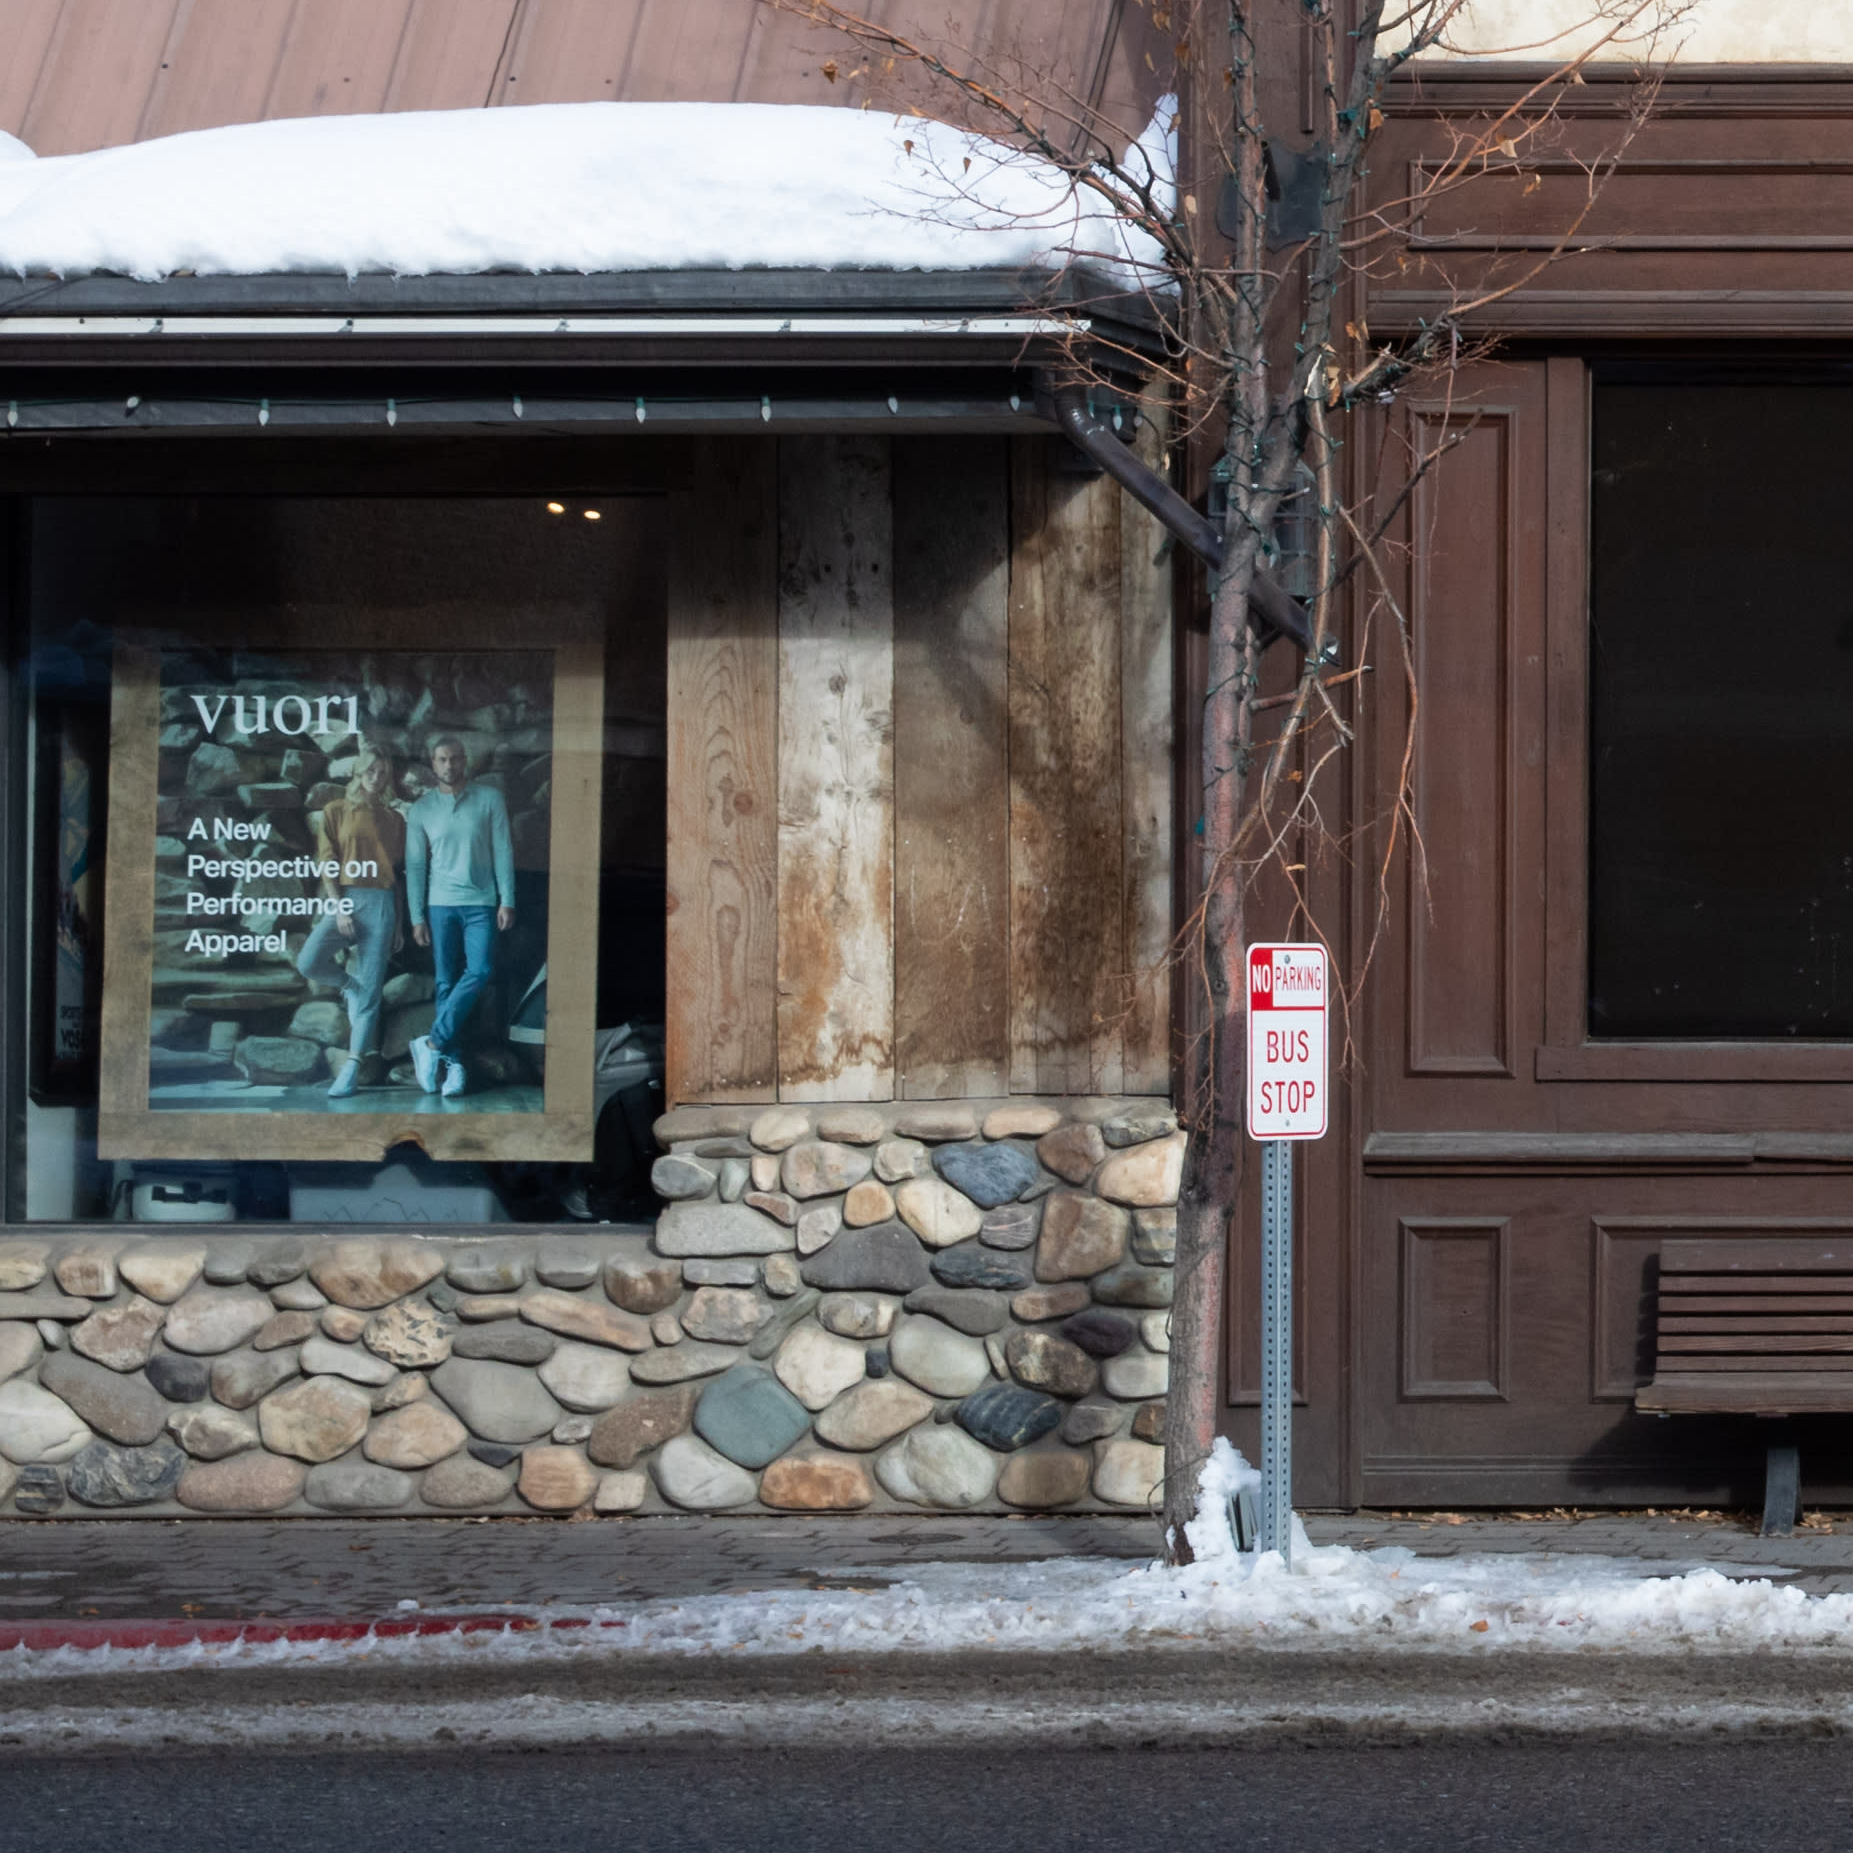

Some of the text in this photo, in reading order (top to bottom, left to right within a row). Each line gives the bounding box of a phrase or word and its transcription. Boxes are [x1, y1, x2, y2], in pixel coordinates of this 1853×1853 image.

[190, 694, 363, 736] vuori
[187, 817, 272, 841] A New
[188, 854, 378, 884] Perspective on
[187, 891, 354, 916] Performance
[185, 930, 287, 958] Apparel
[1252, 964, 1321, 993] NO PARKING
[1266, 1030, 1309, 1063] BUS
[1261, 1080, 1315, 1114] STOP
